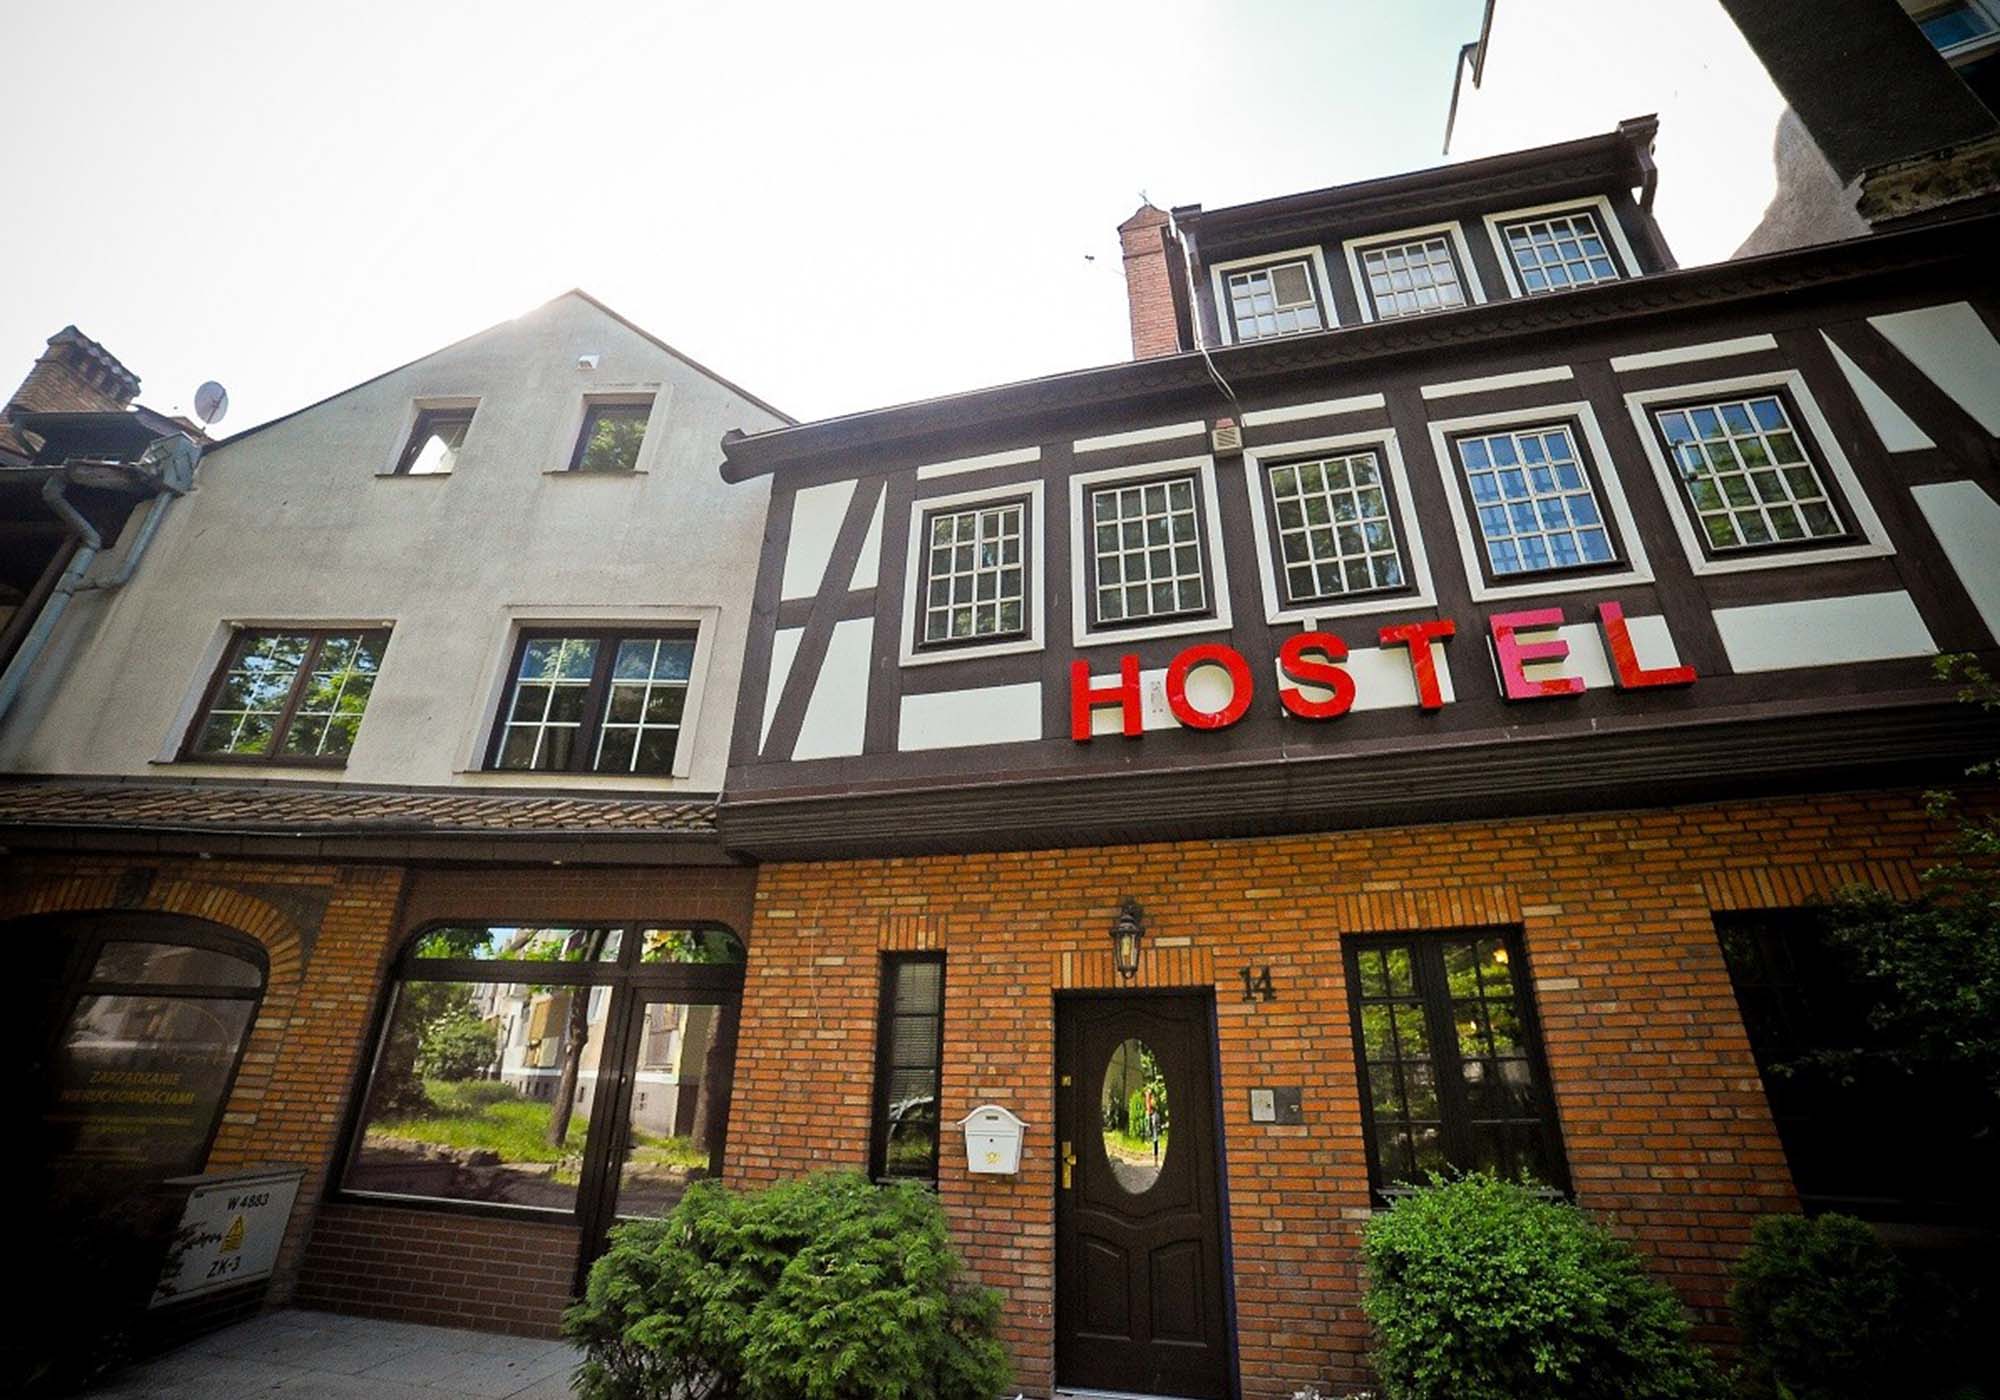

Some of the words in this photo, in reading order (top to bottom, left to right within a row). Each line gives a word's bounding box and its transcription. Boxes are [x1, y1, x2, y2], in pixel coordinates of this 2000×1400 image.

[1071, 601, 1697, 741] HOSTEL
[1239, 965, 1277, 1003] 14
[207, 1256, 241, 1278] ZK-3
